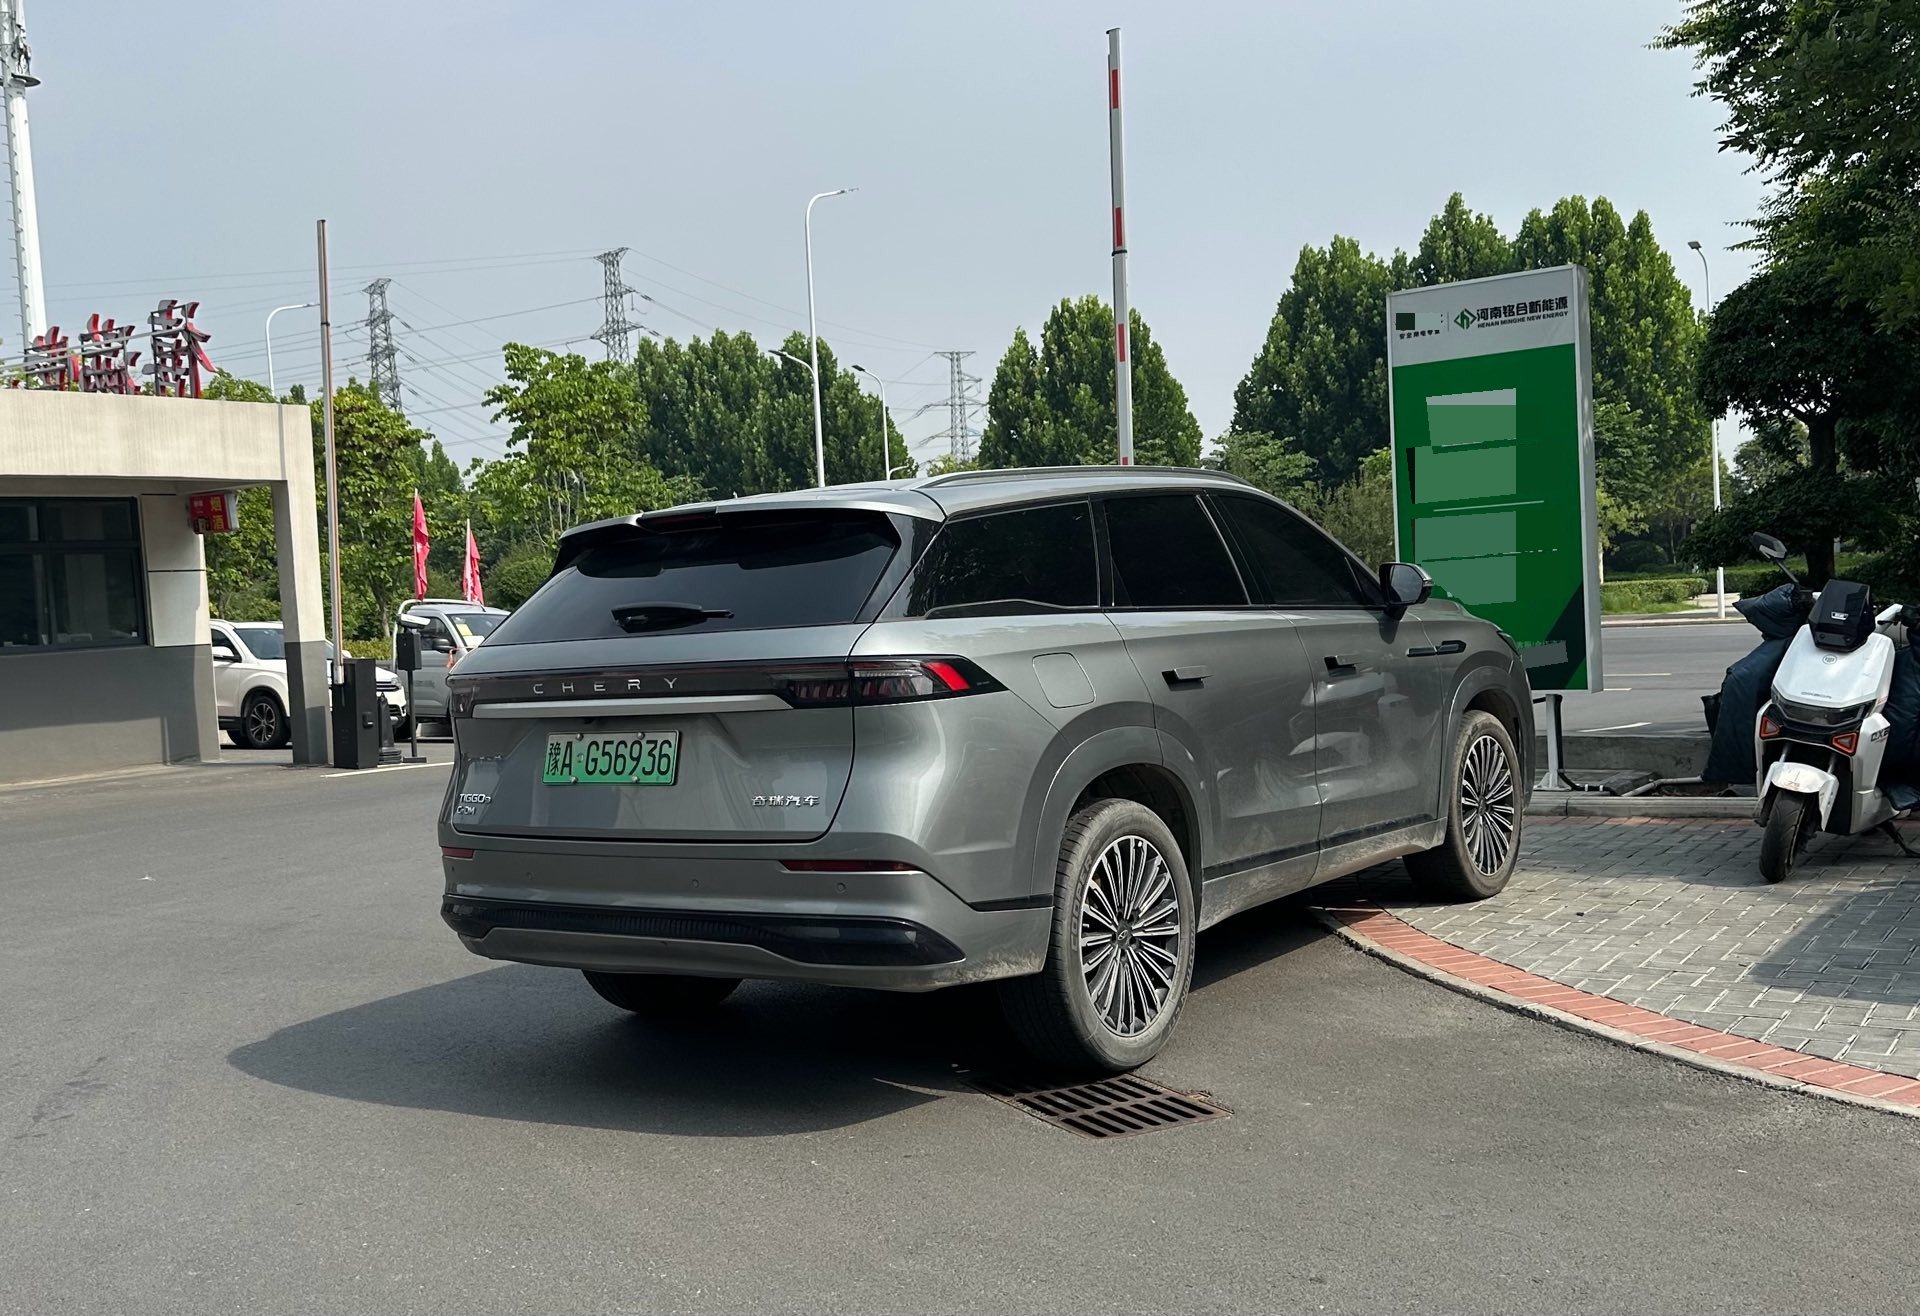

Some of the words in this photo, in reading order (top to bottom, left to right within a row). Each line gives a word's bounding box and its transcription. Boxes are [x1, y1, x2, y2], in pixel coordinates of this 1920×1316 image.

[1478, 321, 1500, 329] HENAN
[1500, 316, 1526, 325] MINGHE
[1527, 314, 1542, 322] NEW
[1542, 311, 1569, 320] ENERGY
[533, 677, 678, 694] CHERY
[751, 795, 820, 806] 奇瑞汽车
[1071, 854, 1092, 952] COOPER
